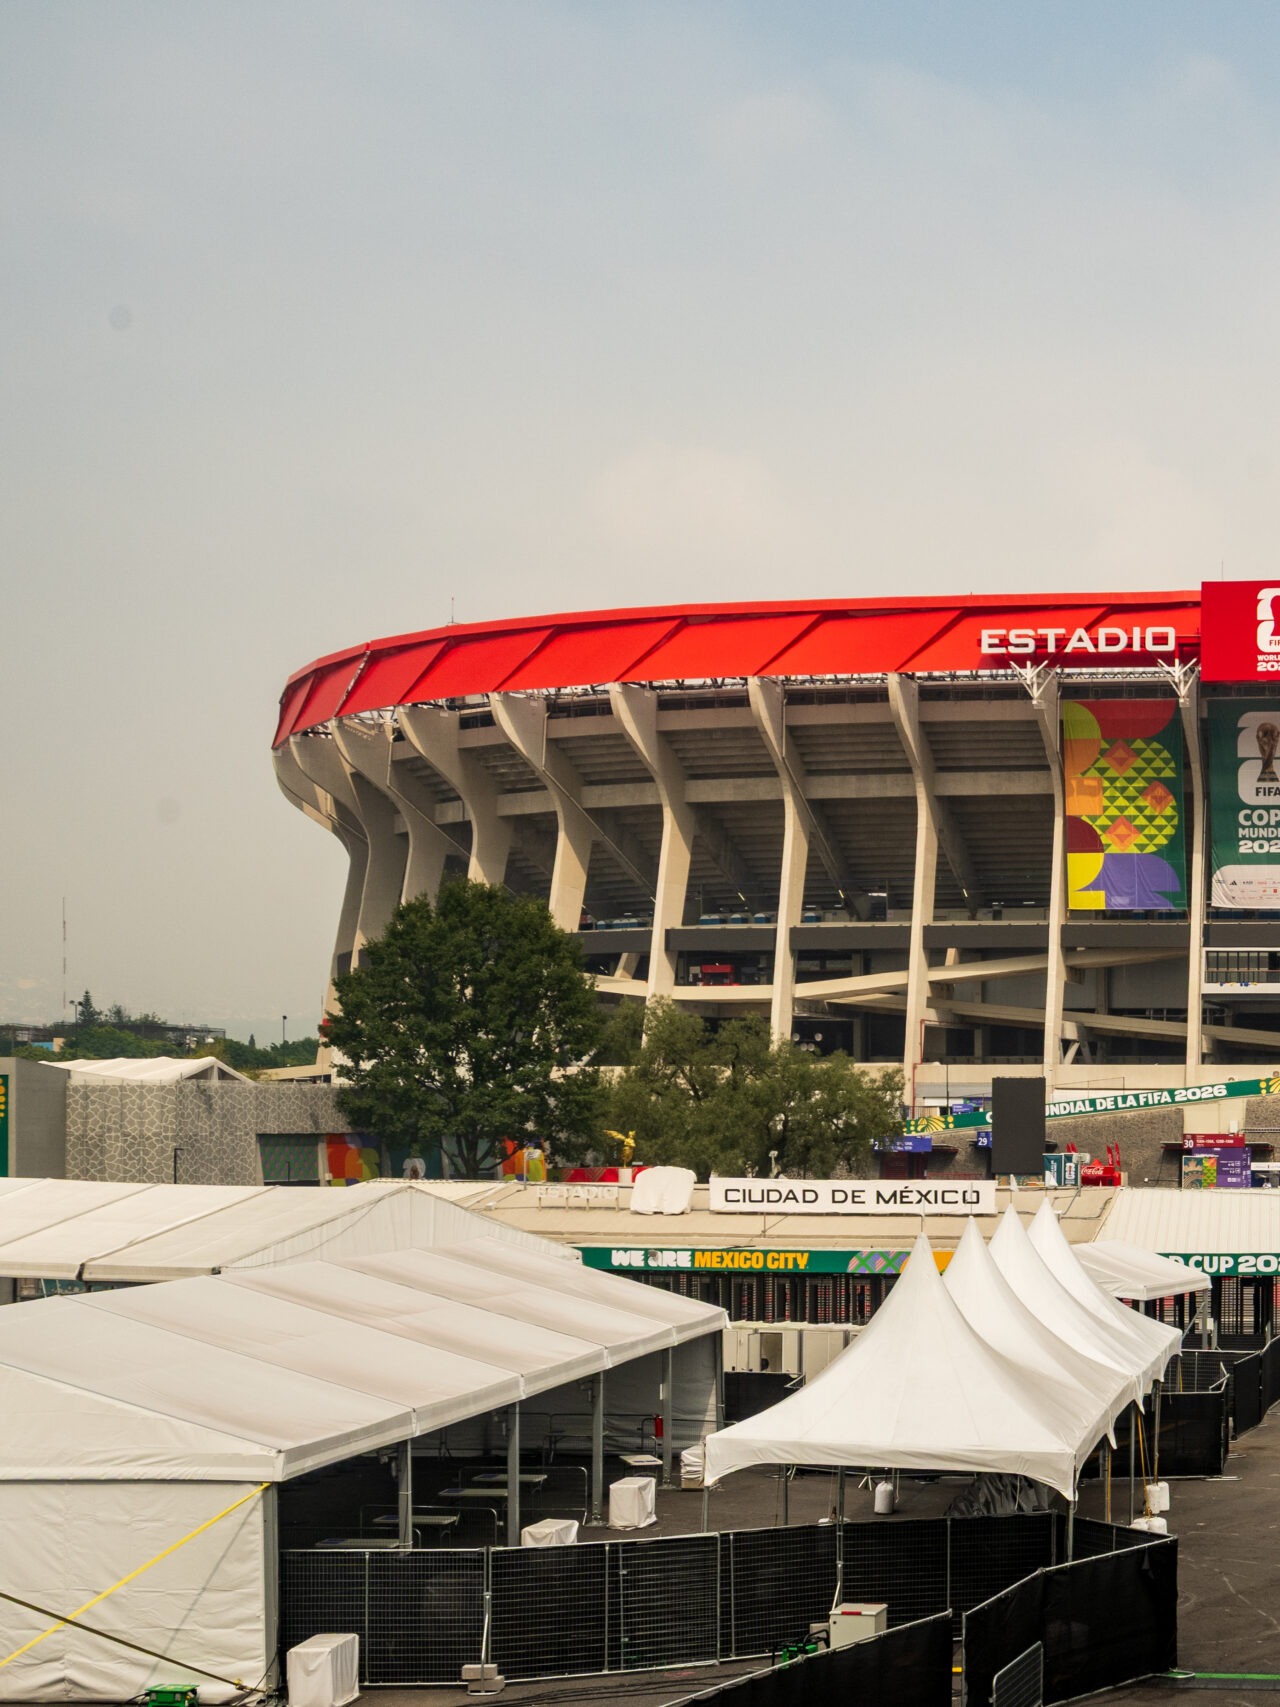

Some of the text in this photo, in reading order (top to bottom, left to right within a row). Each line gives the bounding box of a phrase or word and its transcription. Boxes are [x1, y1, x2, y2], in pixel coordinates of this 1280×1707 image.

[981, 626, 1176, 654] ESTADIO
[1096, 1096, 1116, 1111] DE
[1117, 1093, 1138, 1108] LA
[1139, 1088, 1172, 1106] FIFA
[1174, 1084, 1228, 1102] 2026
[978, 1137, 988, 1146] 29
[1183, 1139, 1194, 1149] 30
[1081, 1166, 1104, 1175] Coca-Cola
[537, 1186, 619, 1199] ESTADIO
[724, 1186, 980, 1205] CIUDAD DE MÉXICO
[611, 1250, 645, 1267] WE
[694, 1251, 764, 1269] MEXICO
[766, 1252, 809, 1269] CITY
[1188, 1255, 1234, 1273] CUP
